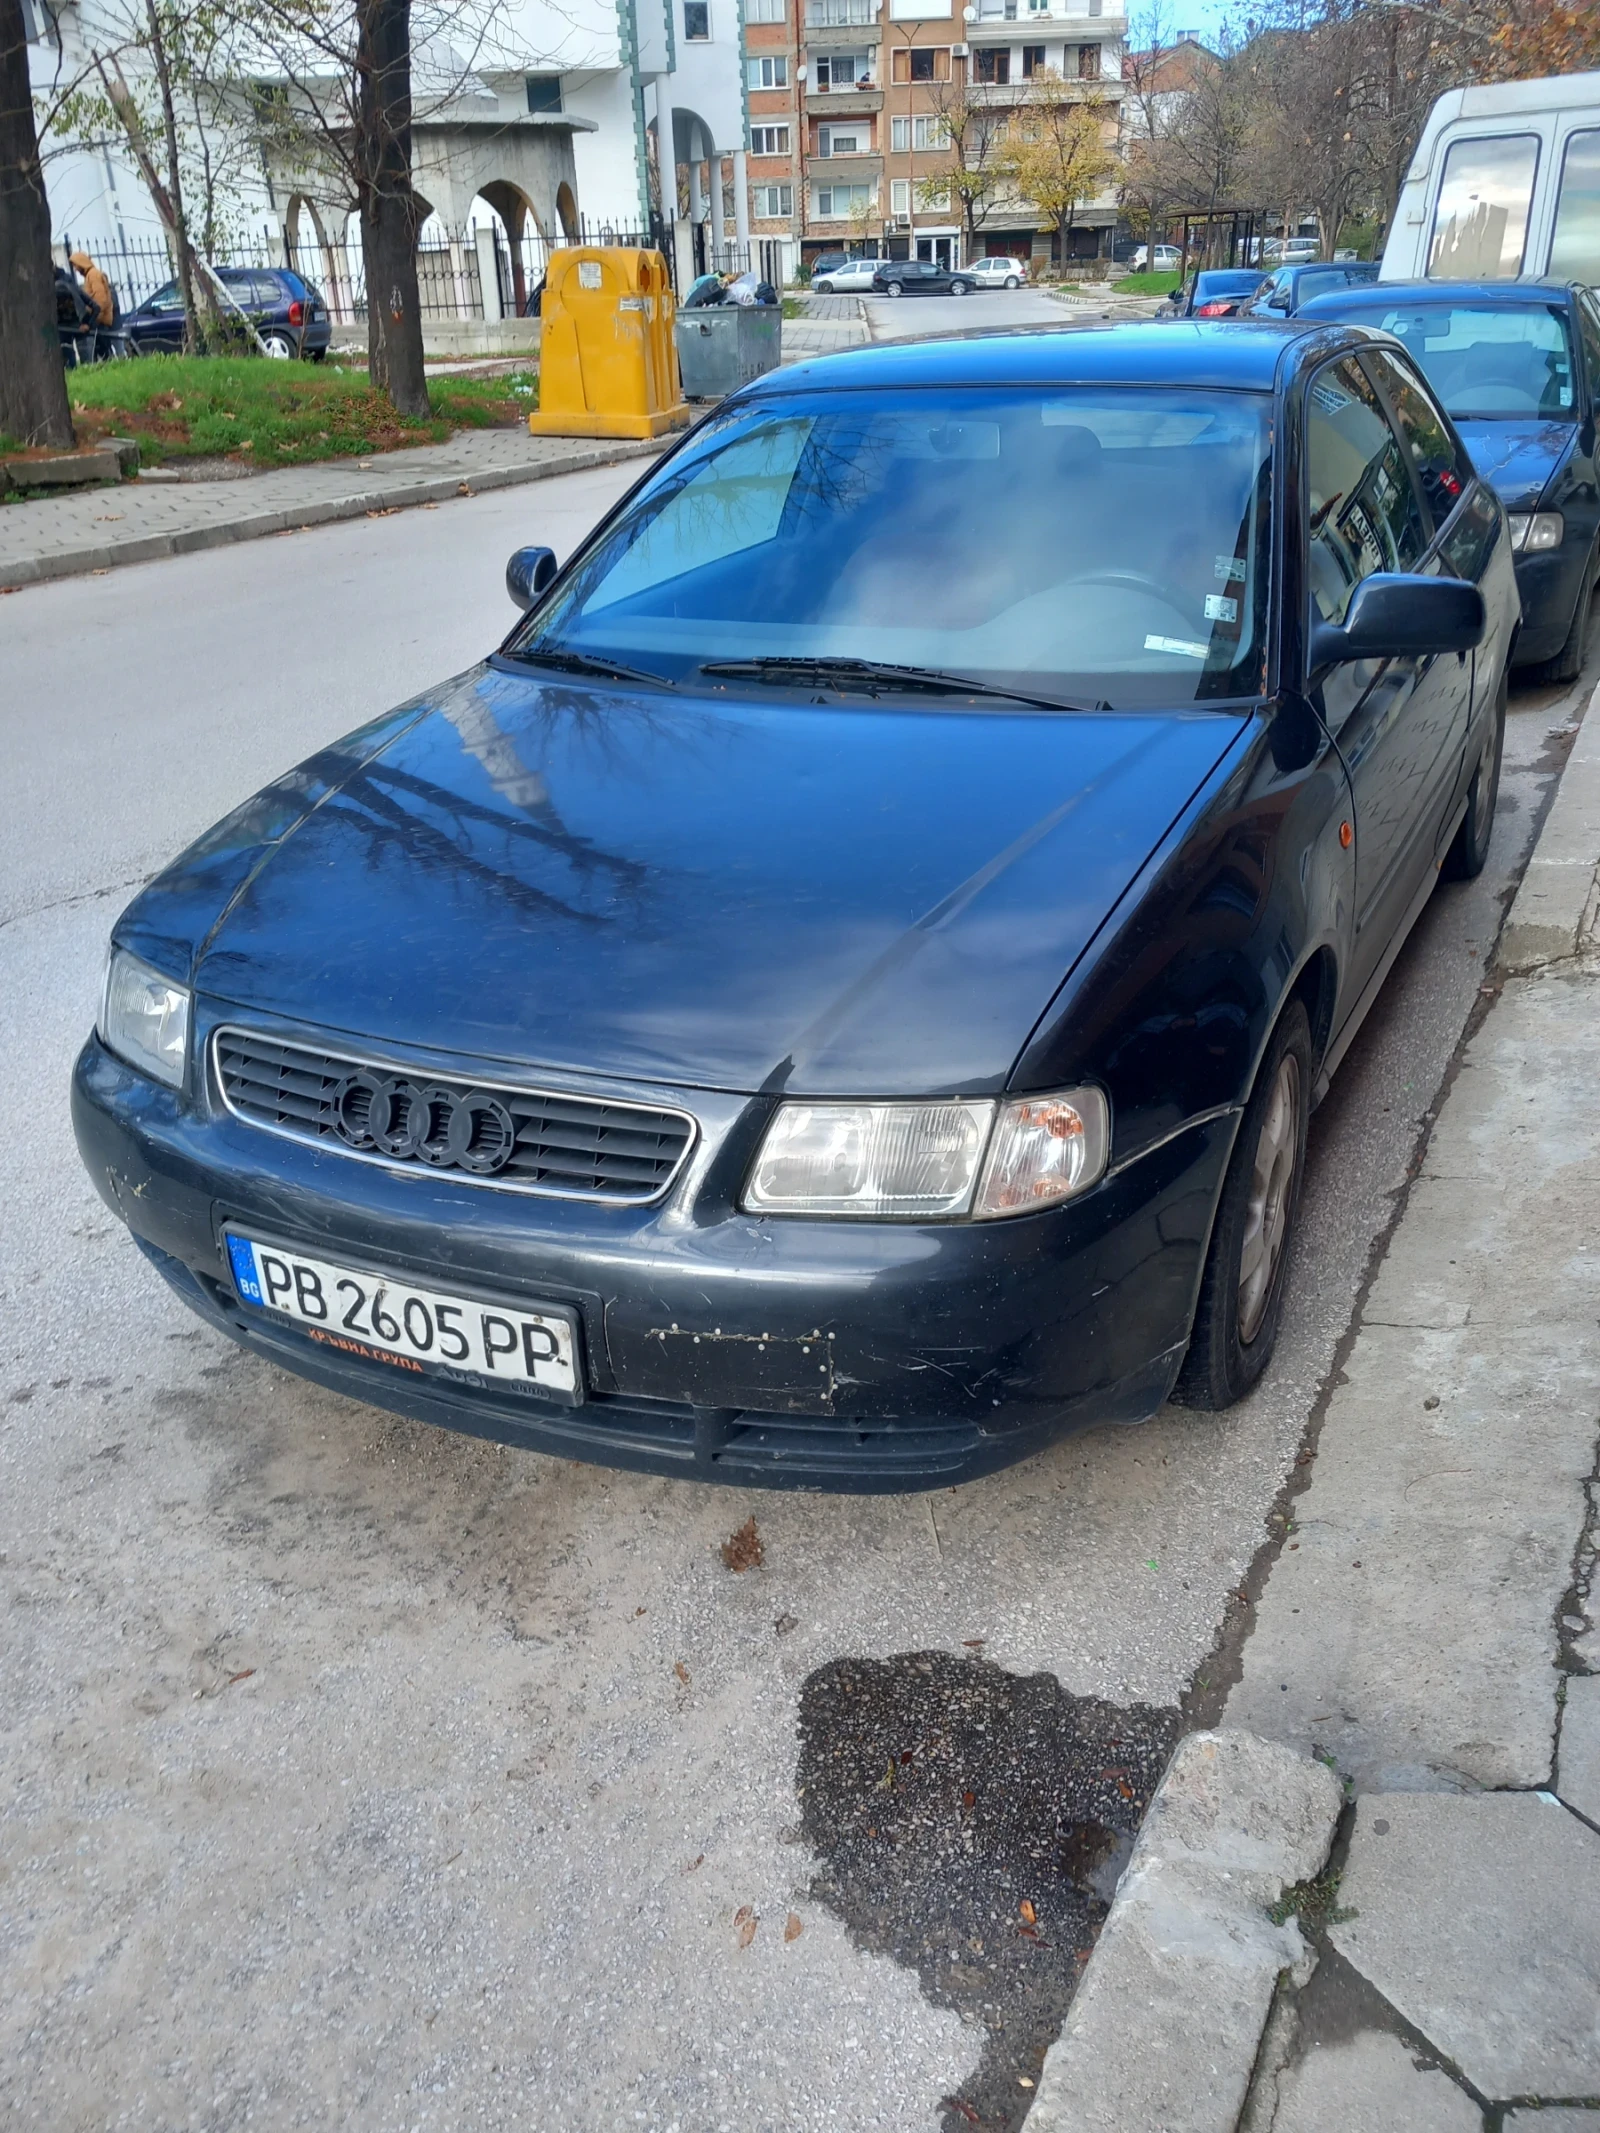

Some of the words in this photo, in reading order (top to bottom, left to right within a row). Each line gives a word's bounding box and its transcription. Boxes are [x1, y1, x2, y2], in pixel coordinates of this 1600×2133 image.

[240, 1277, 259, 1298] BG
[261, 1255, 328, 1319] PB
[338, 1279, 469, 1360] 2605
[482, 1314, 560, 1377] PP
[308, 1328, 369, 1357] КРЪВНА
[372, 1350, 423, 1372] ГРУПА
